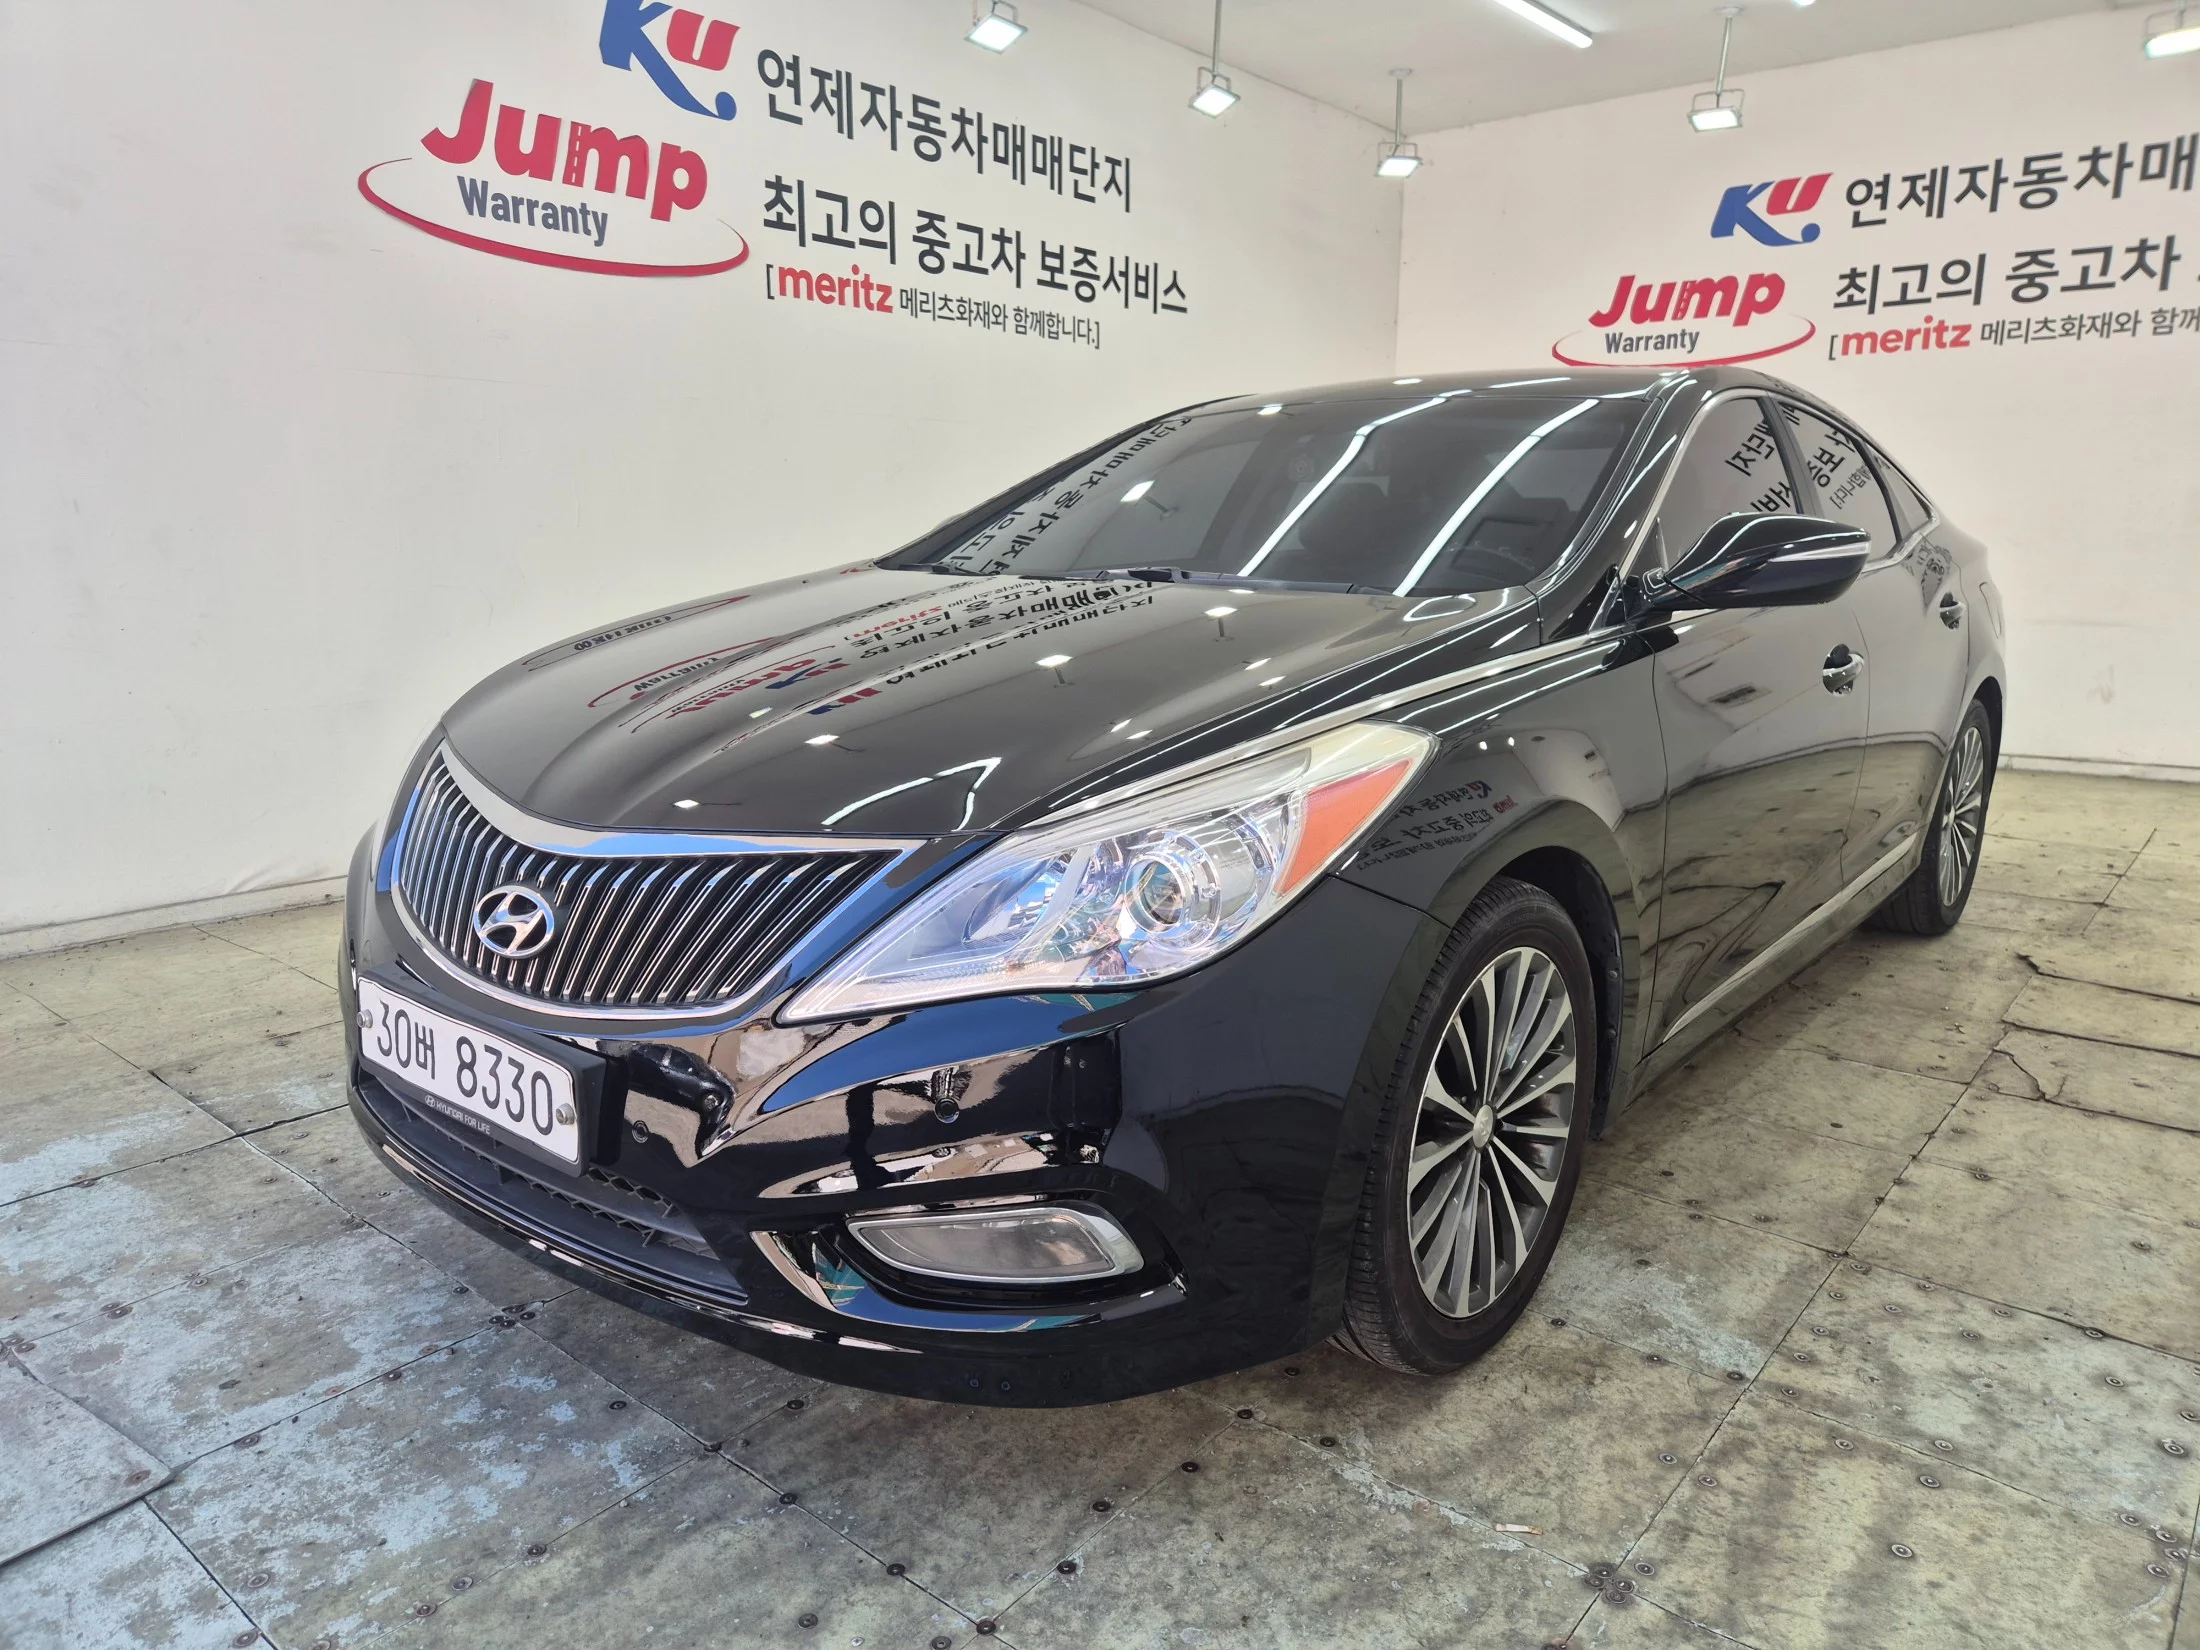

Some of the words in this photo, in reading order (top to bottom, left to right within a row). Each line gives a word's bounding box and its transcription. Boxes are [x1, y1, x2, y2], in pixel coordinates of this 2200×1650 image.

[420, 78, 708, 222] Jump
[757, 48, 1131, 213] 연제자동차매매단지
[456, 175, 608, 247] Warranty
[1844, 132, 2200, 229] 연제자동차매
[763, 175, 897, 265] 최고의
[912, 209, 1026, 289] 중고차
[1036, 240, 1188, 314] 보증서비스
[1833, 254, 1987, 312] 최고의
[2005, 235, 2182, 303] 중고차
[899, 287, 1008, 332] 메리츠화재와
[1588, 272, 1786, 327] Jump
[1980, 310, 2142, 347] 메리츠화재와
[1604, 328, 1700, 354] Warranty
[377, 1000, 436, 1080] 30버
[456, 1035, 553, 1136] 8330
[464, 1114, 477, 1129] FOR
[477, 1120, 490, 1135] LIFE
